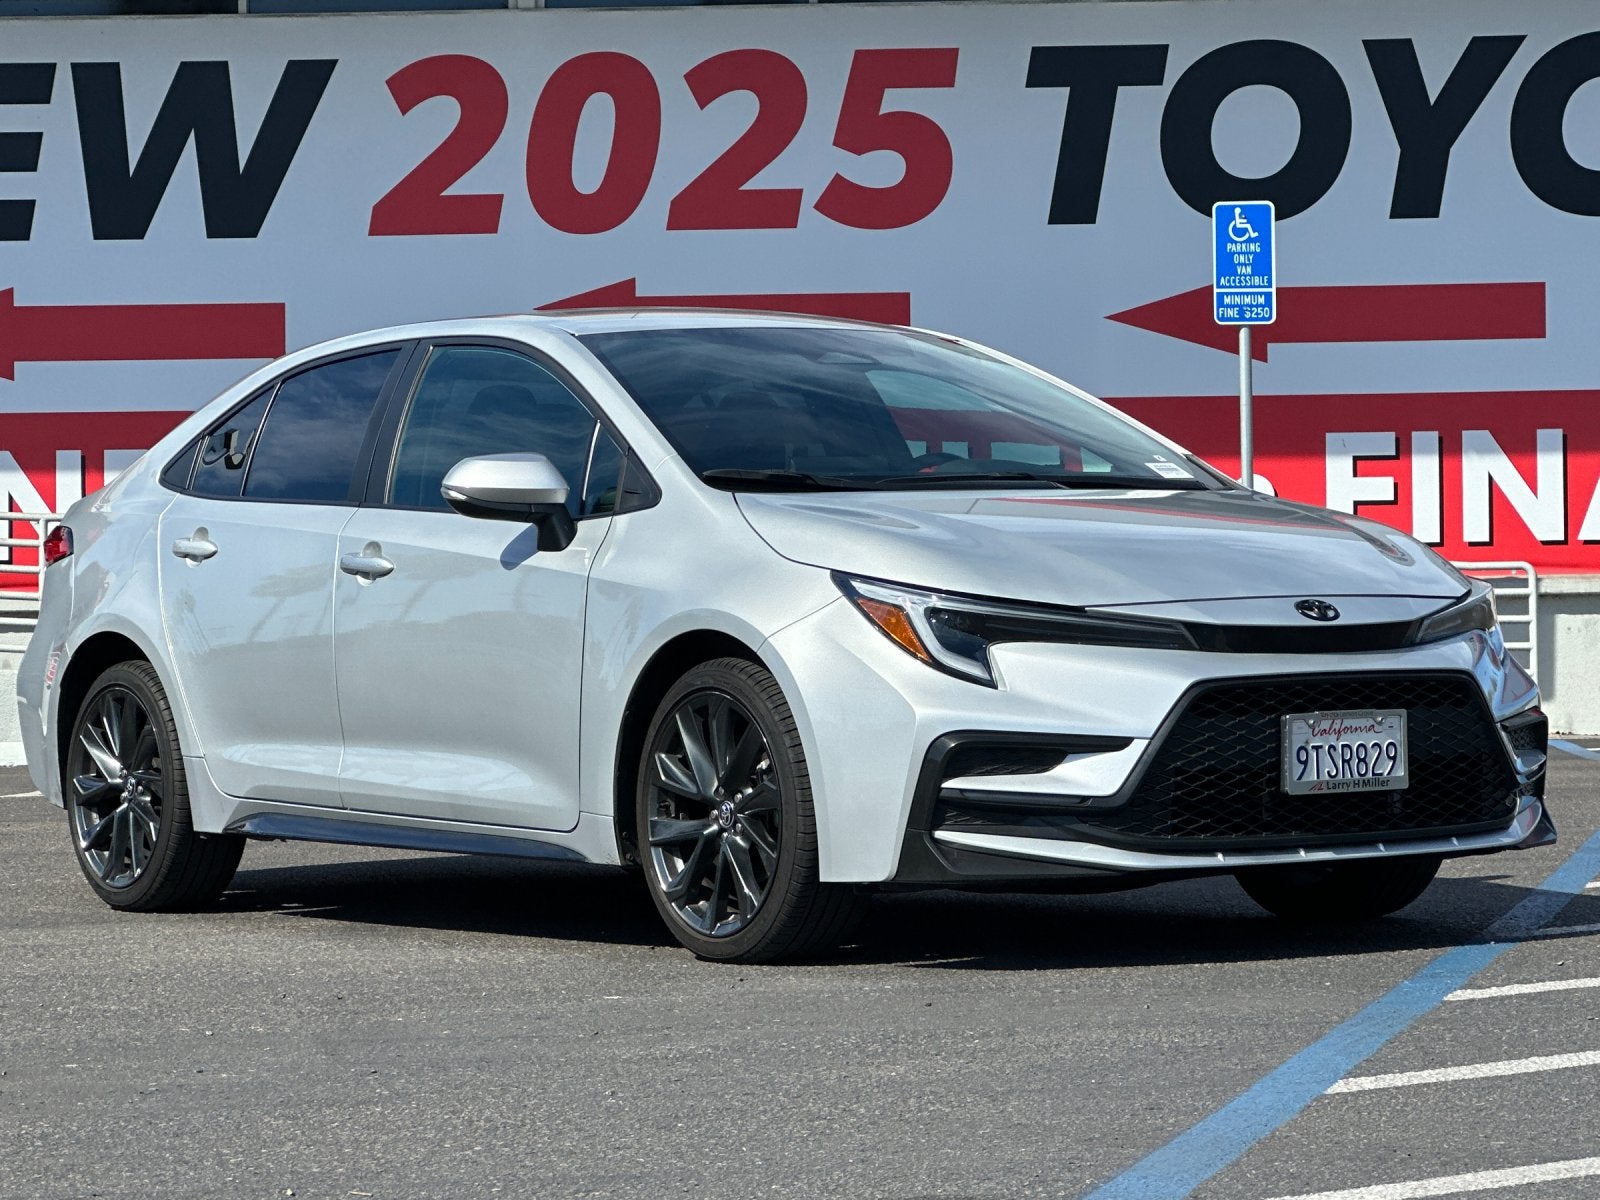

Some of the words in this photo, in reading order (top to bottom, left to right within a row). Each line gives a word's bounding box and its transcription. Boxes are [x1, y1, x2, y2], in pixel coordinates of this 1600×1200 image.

[368, 48, 959, 236] 2025
[1227, 243, 1260, 252] PARKING
[1233, 254, 1254, 264] ONLY
[1237, 265, 1252, 275] VAN
[1220, 276, 1269, 286] ACCESSIBLE
[1224, 295, 1265, 305] MINIMUM
[1219, 307, 1239, 318] FINE
[1244, 307, 1270, 318] $250
[1325, 428, 1600, 544] FIN
[1312, 720, 1382, 741] California
[1296, 741, 1398, 780] 9TSR829
[1326, 781, 1351, 791] Larry
[1362, 778, 1390, 788] Miller
